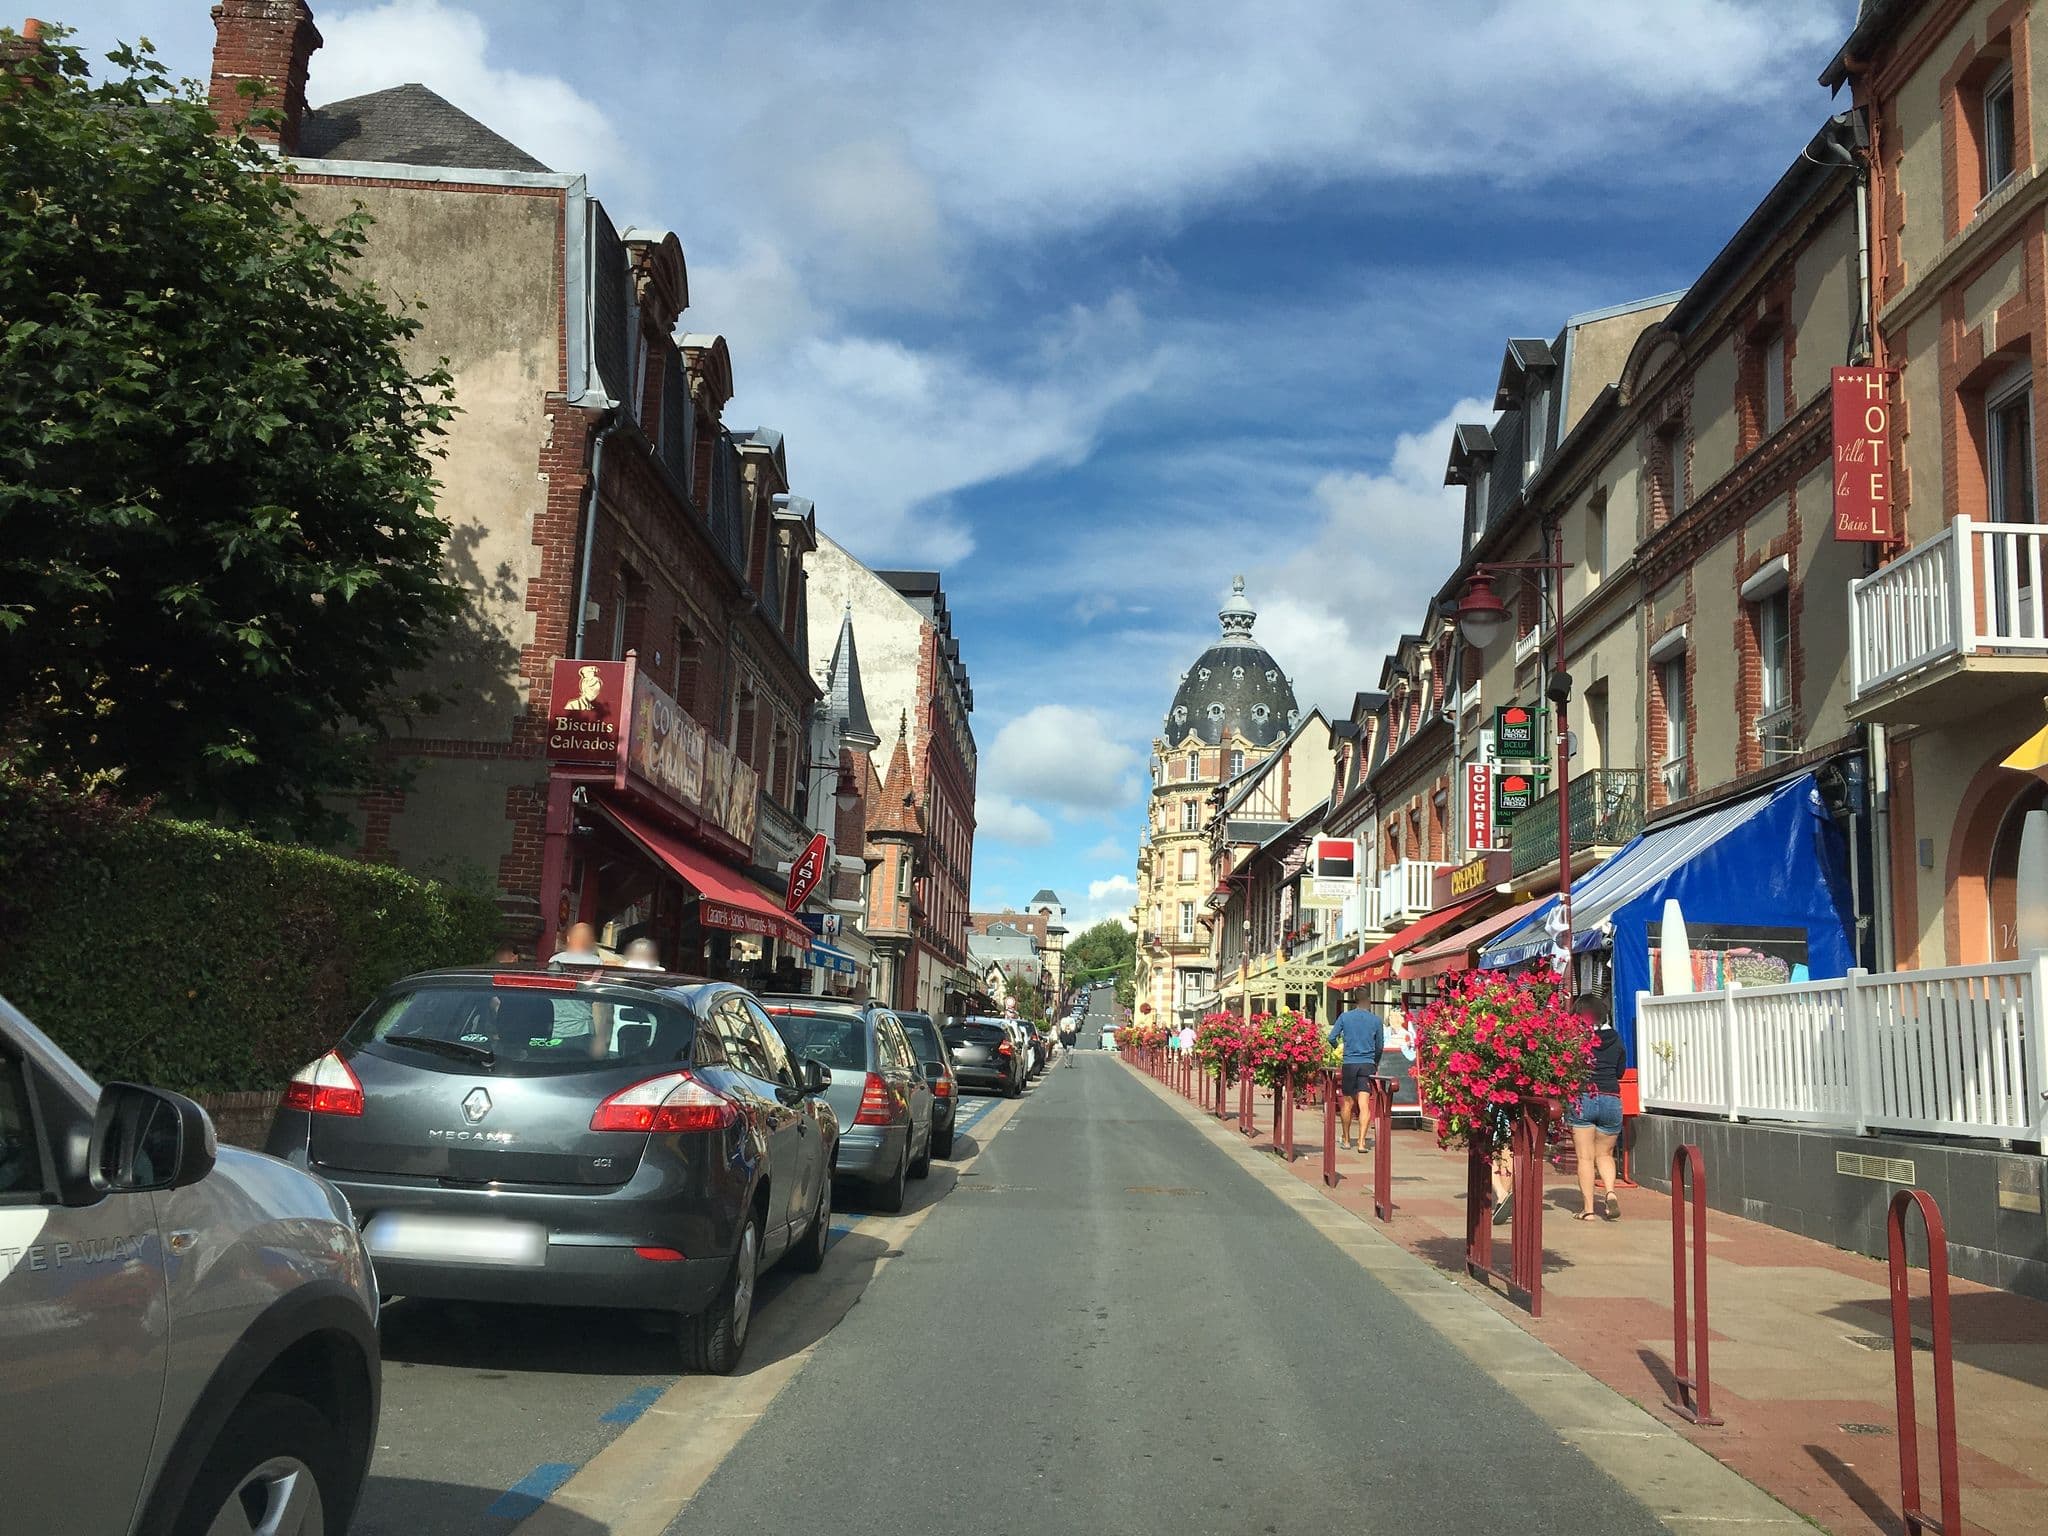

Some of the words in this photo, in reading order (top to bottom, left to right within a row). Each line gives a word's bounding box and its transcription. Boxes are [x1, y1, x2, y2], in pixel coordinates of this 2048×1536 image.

[1837, 438, 1865, 463] Villa
[1865, 373, 1885, 534] HOTEL
[1836, 471, 1850, 496] les
[1838, 513, 1868, 531] Bains
[555, 716, 614, 733] Biscuits
[550, 734, 616, 751] Calvados
[1472, 765, 1487, 849] BOUCHERIE
[793, 851, 818, 897] TABAC
[429, 1129, 513, 1144] MEGANE
